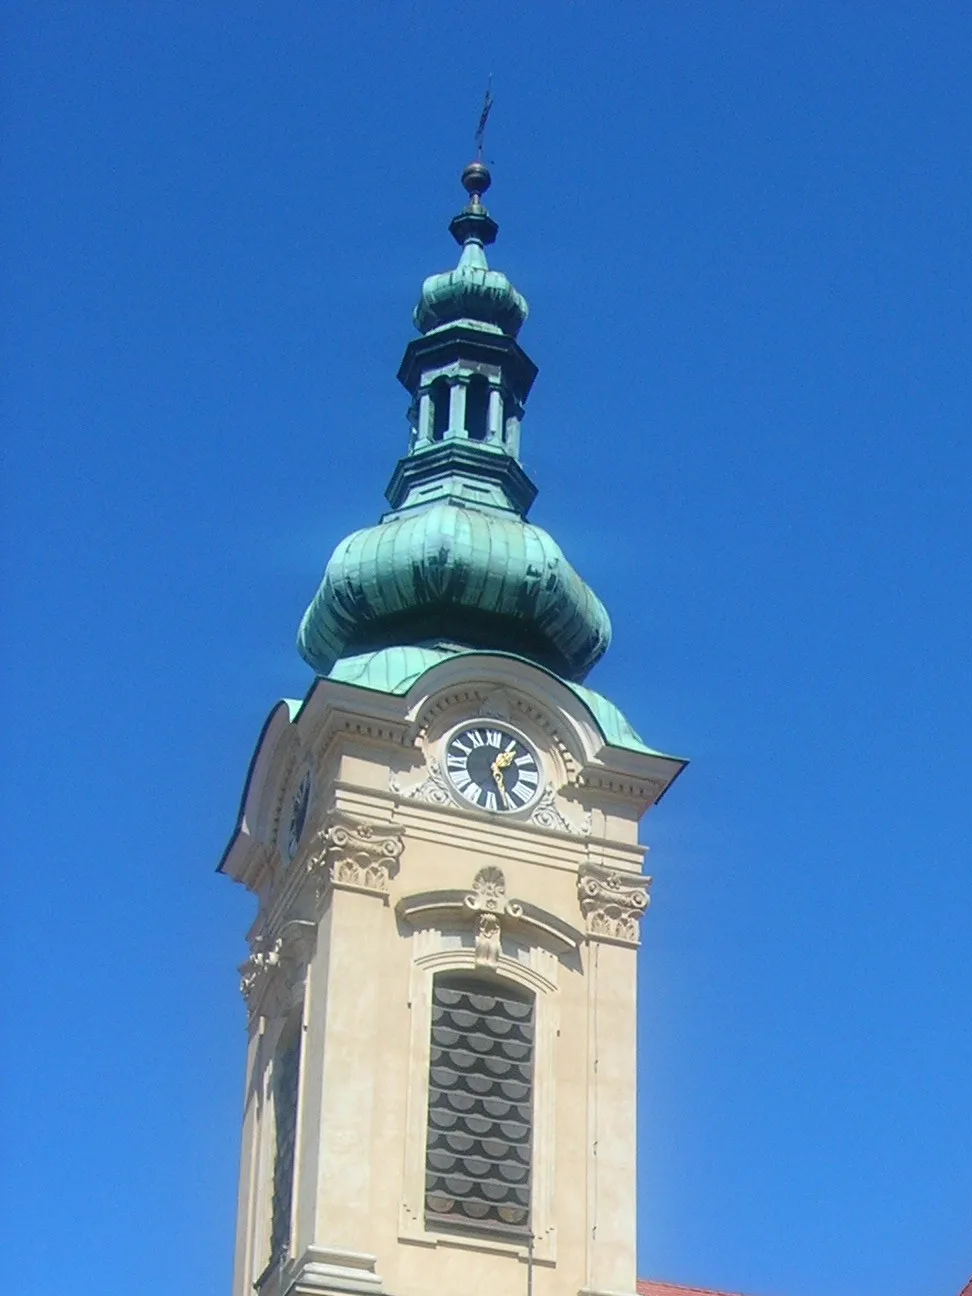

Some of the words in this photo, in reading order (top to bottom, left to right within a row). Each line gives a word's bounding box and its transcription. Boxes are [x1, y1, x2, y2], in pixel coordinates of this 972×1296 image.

[467, 729, 484, 749] XI
[486, 729, 502, 749] XII
[452, 739, 472, 756] X
[447, 753, 468, 769] IX
[514, 753, 534, 766] II
[518, 769, 538, 785] III
